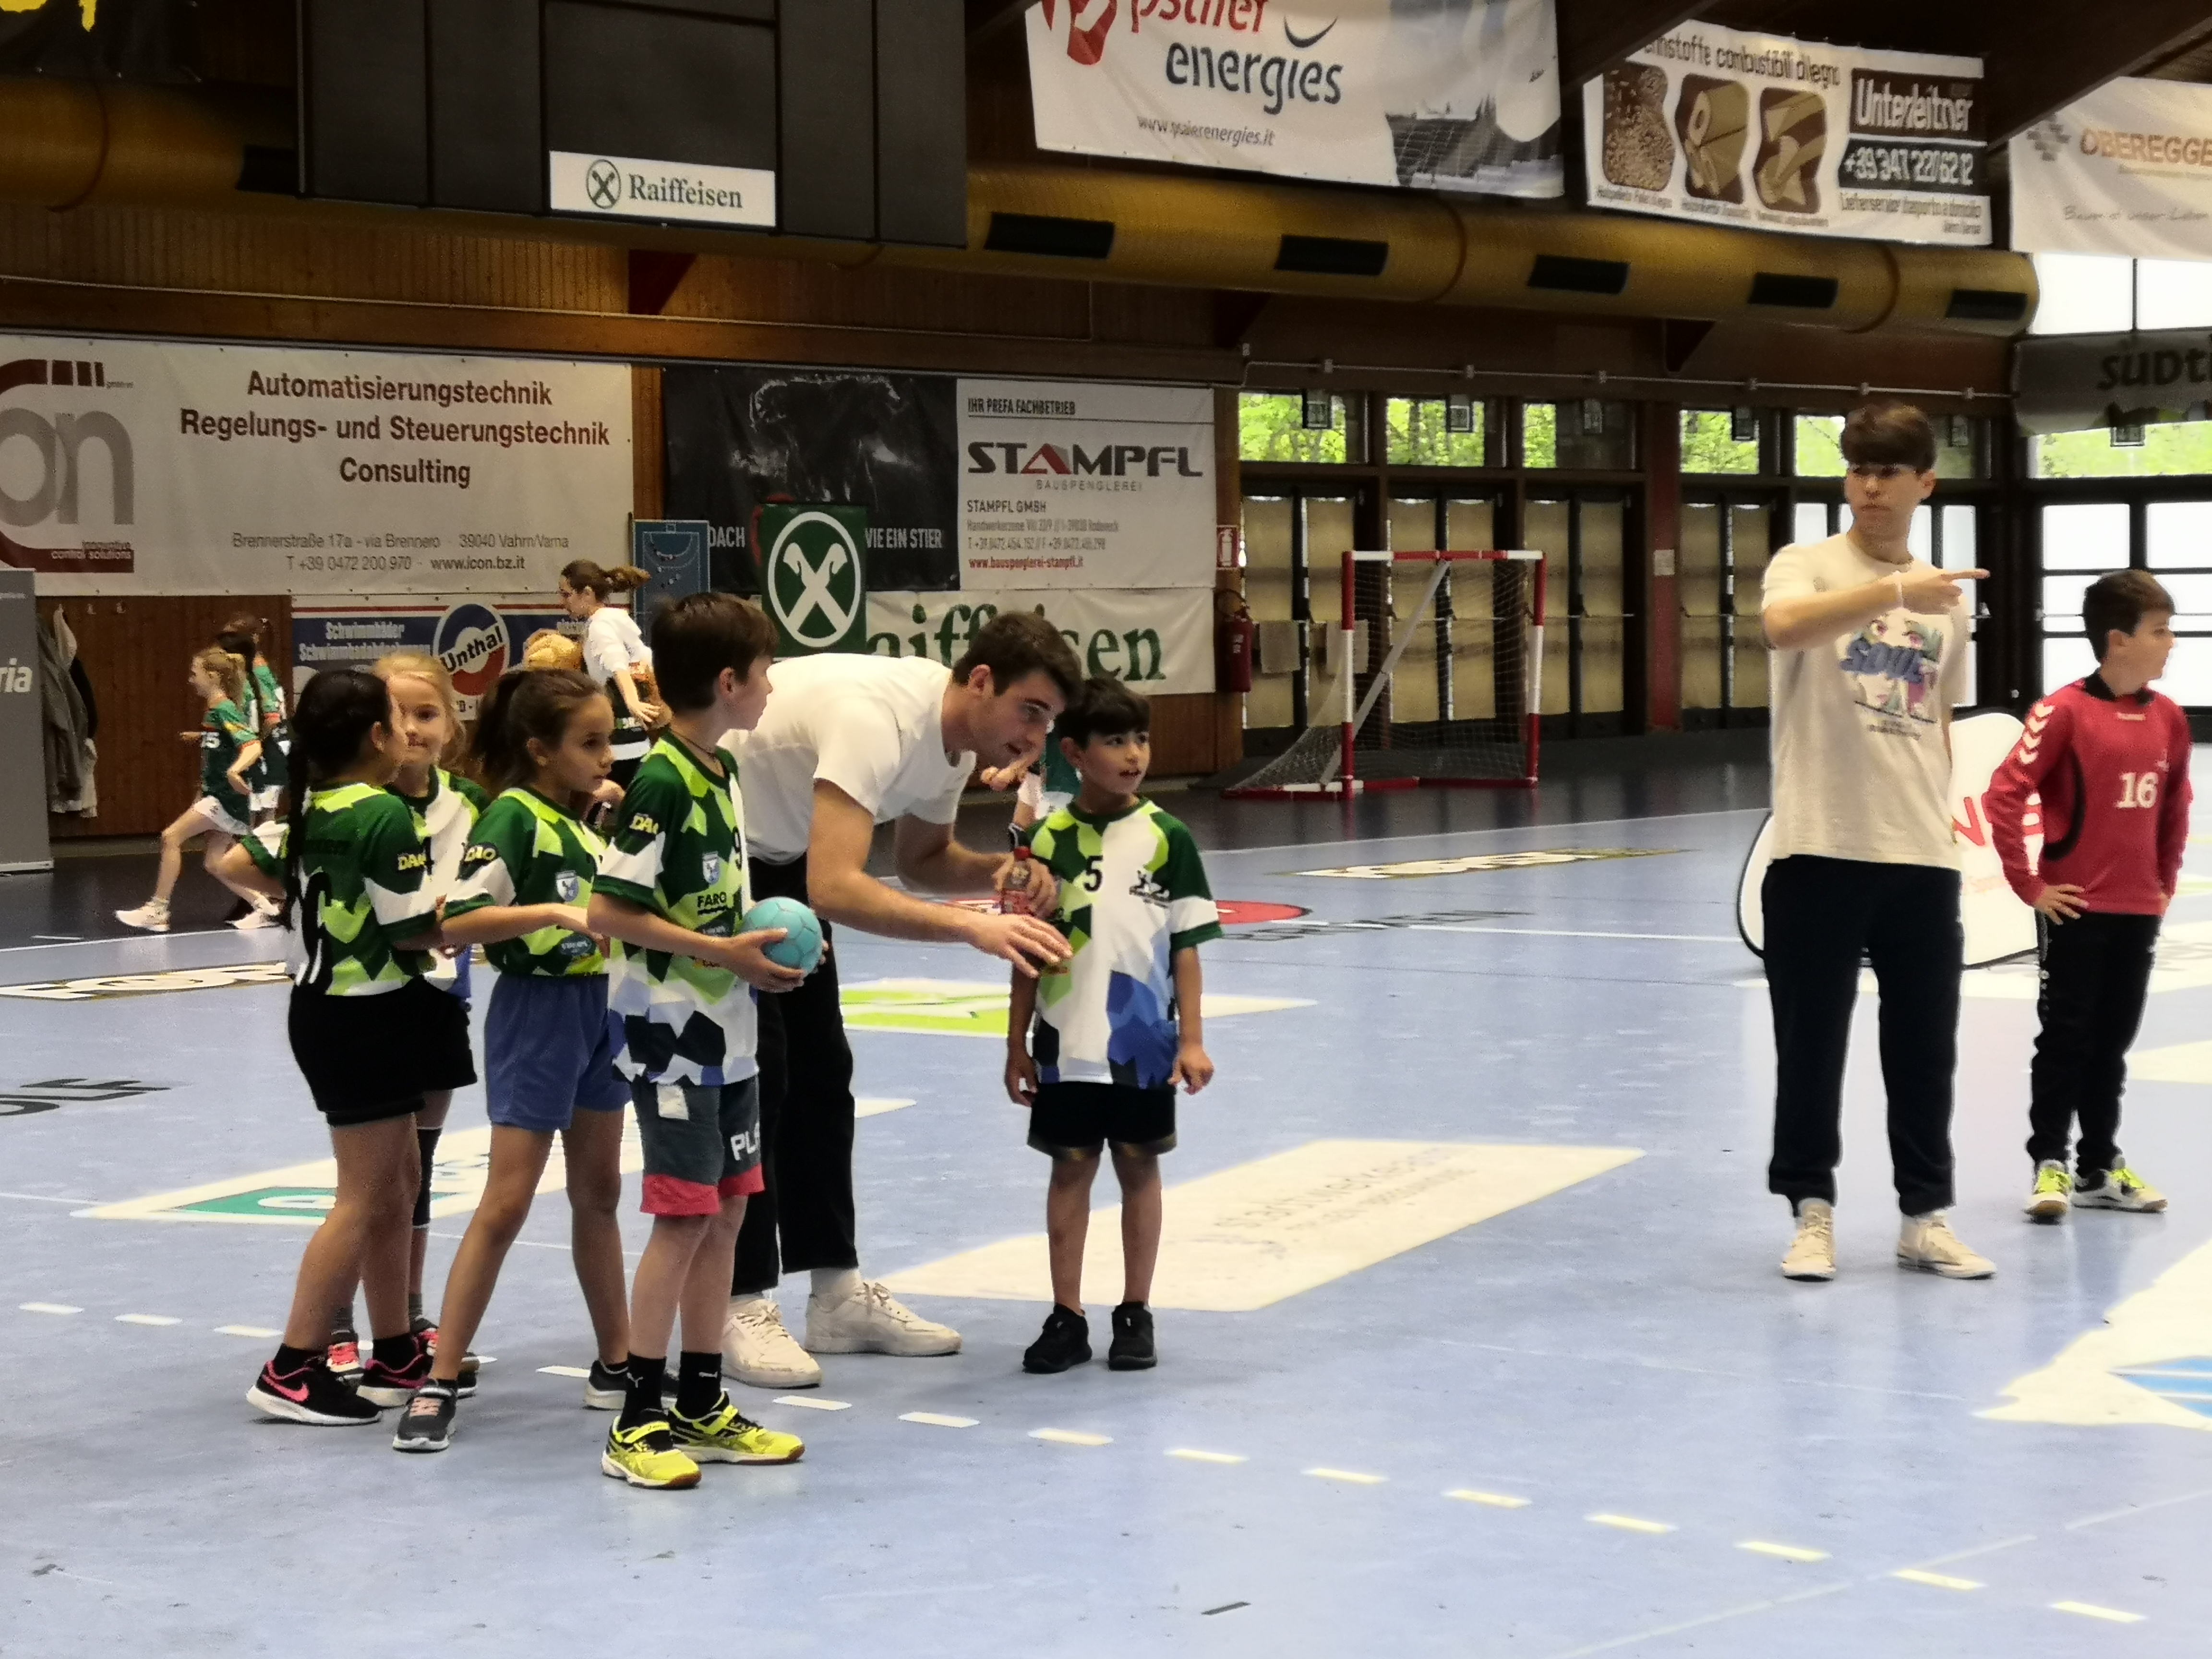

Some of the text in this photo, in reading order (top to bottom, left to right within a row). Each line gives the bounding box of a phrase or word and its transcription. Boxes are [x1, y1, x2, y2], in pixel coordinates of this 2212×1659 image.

[1166, 42, 1343, 115] energies
[629, 174, 743, 208] Raiffeisen
[247, 370, 552, 408] Automatisierungstechnik
[968, 398, 984, 412] IHR
[180, 409, 610, 448] Regelungs- und Steuerungstechnik
[340, 457, 470, 489] Consulting
[968, 442, 1203, 477] STAMPFL
[967, 499, 1014, 513] STAMPFL
[458, 533, 495, 548] 39040
[708, 527, 745, 548] DACH
[887, 528, 907, 548] EIN
[910, 529, 943, 548] STIER
[286, 554, 525, 571] T +39 0472 200 970 www.icon.bz.it
[440, 626, 503, 673] Unthal
[2116, 772, 2159, 809] 16
[1084, 855, 1103, 892] 5
[697, 891, 727, 908] FARO
